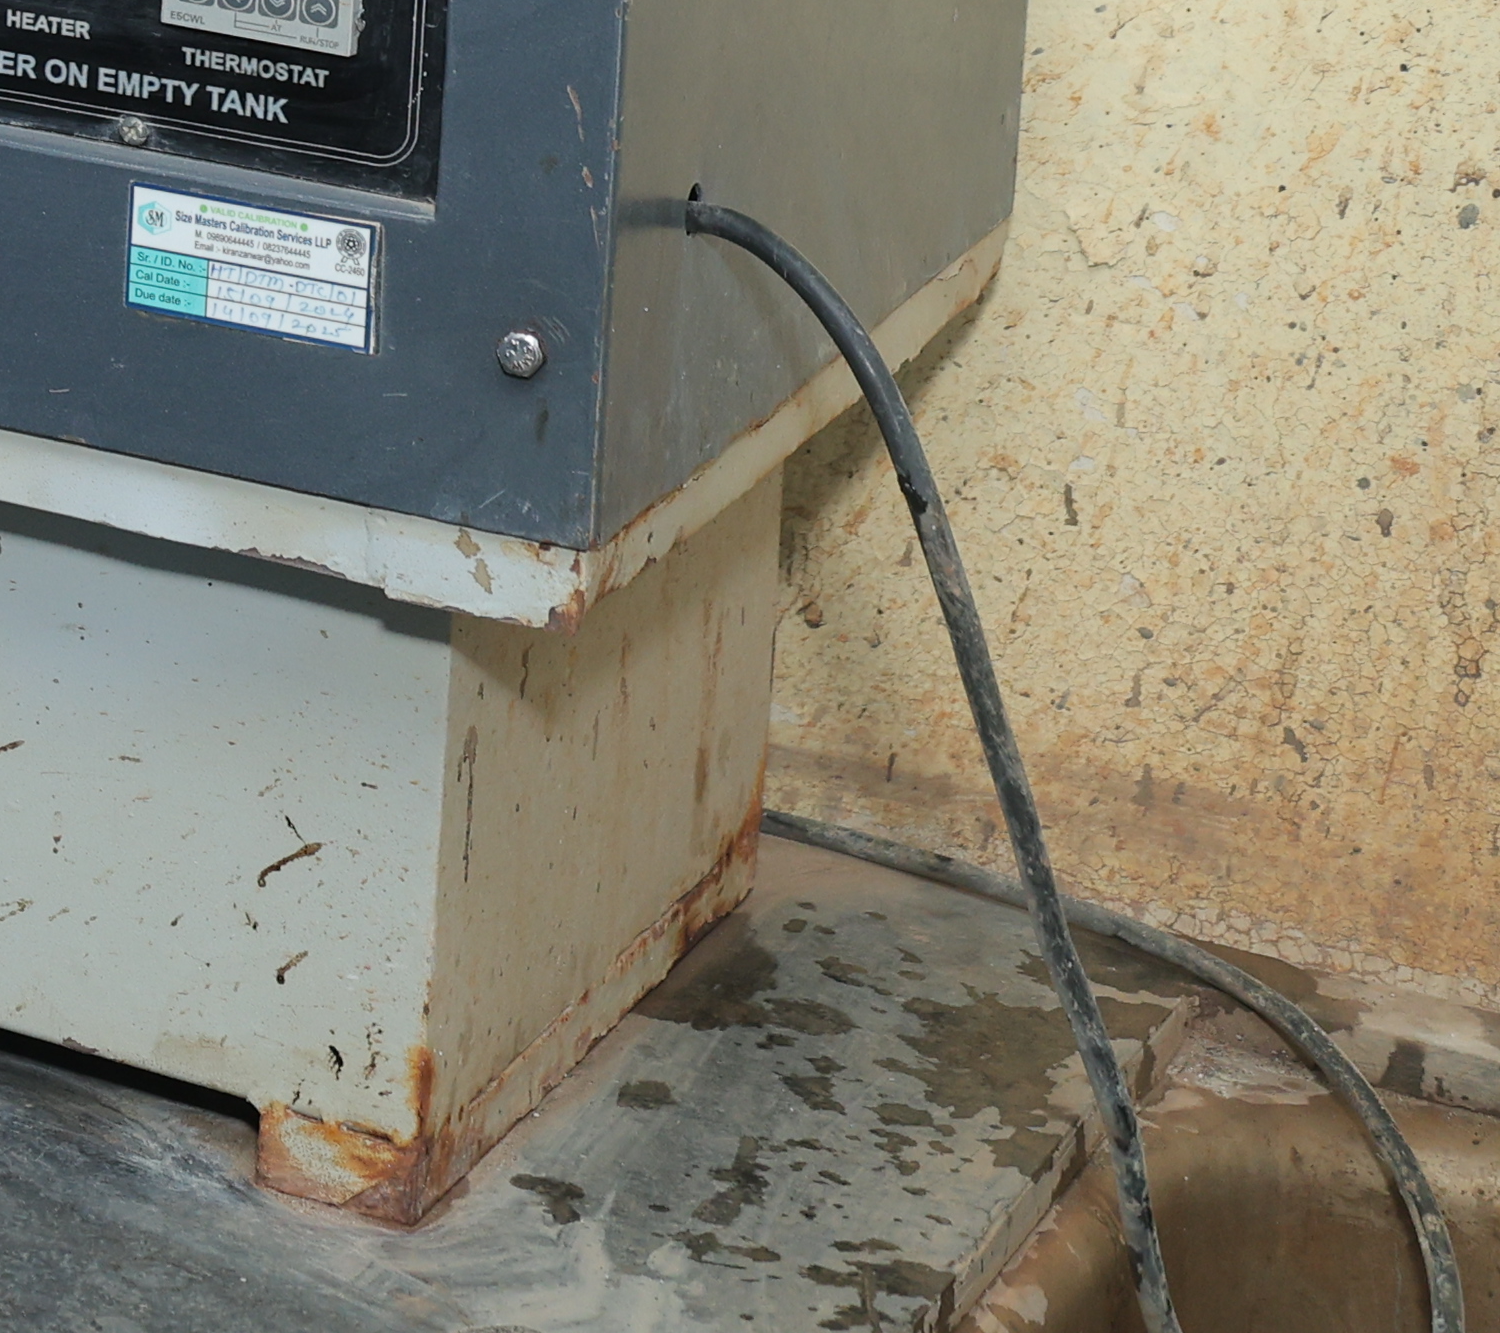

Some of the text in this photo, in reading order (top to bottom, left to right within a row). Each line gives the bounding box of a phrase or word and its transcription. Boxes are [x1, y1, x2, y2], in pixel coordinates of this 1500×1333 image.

[6, 8, 91, 40] HEATER
[170, 10, 206, 25] E5CWL
[181, 46, 330, 88] THERMOSTAT
[44, 58, 89, 89] ON
[99, 67, 200, 107] EMPTY
[206, 85, 289, 124] TANK
[210, 206, 298, 229] VALID CALIBRATION
[175, 210, 193, 224] Size
[194, 214, 228, 231] Masters
[229, 220, 275, 240] Calibration
[276, 229, 313, 247] Services
[314, 236, 332, 249] LLP
[194, 241, 214, 253] Email
[137, 251, 152, 264] Sr.
[160, 255, 175, 268] ID.
[178, 259, 196, 272] No.
[135, 269, 154, 282] Cal
[156, 273, 181, 287] Date
[135, 288, 158, 303] Due
[159, 292, 183, 307] date
